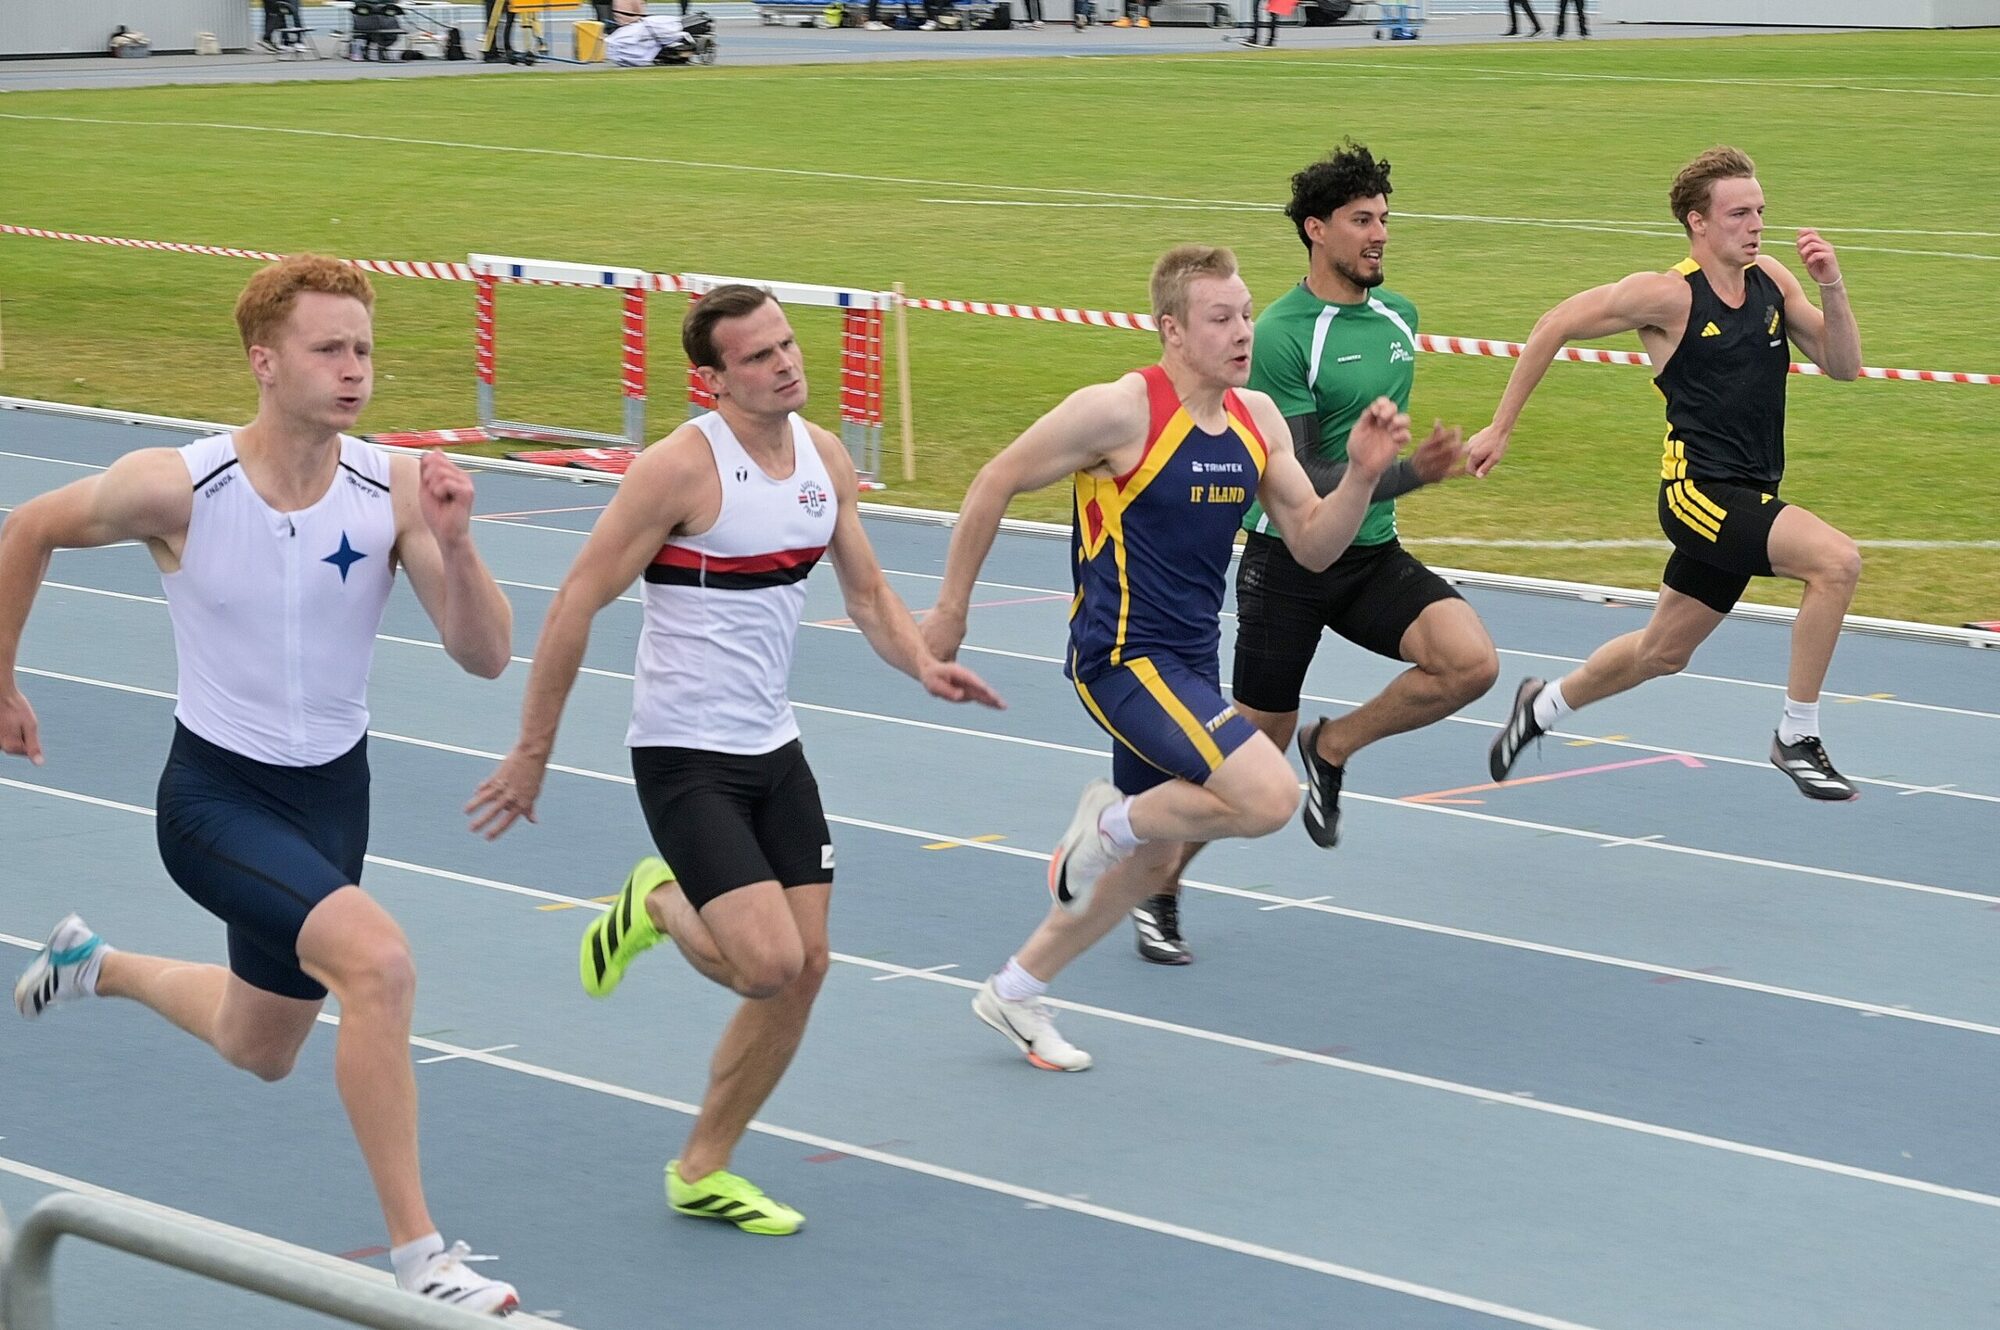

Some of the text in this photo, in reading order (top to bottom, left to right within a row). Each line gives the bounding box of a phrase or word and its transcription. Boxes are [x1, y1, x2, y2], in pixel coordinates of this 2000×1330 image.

[1204, 463, 1243, 473] TRIMTEX
[808, 490, 819, 507] H
[1190, 483, 1245, 503] IF ÅLAND
